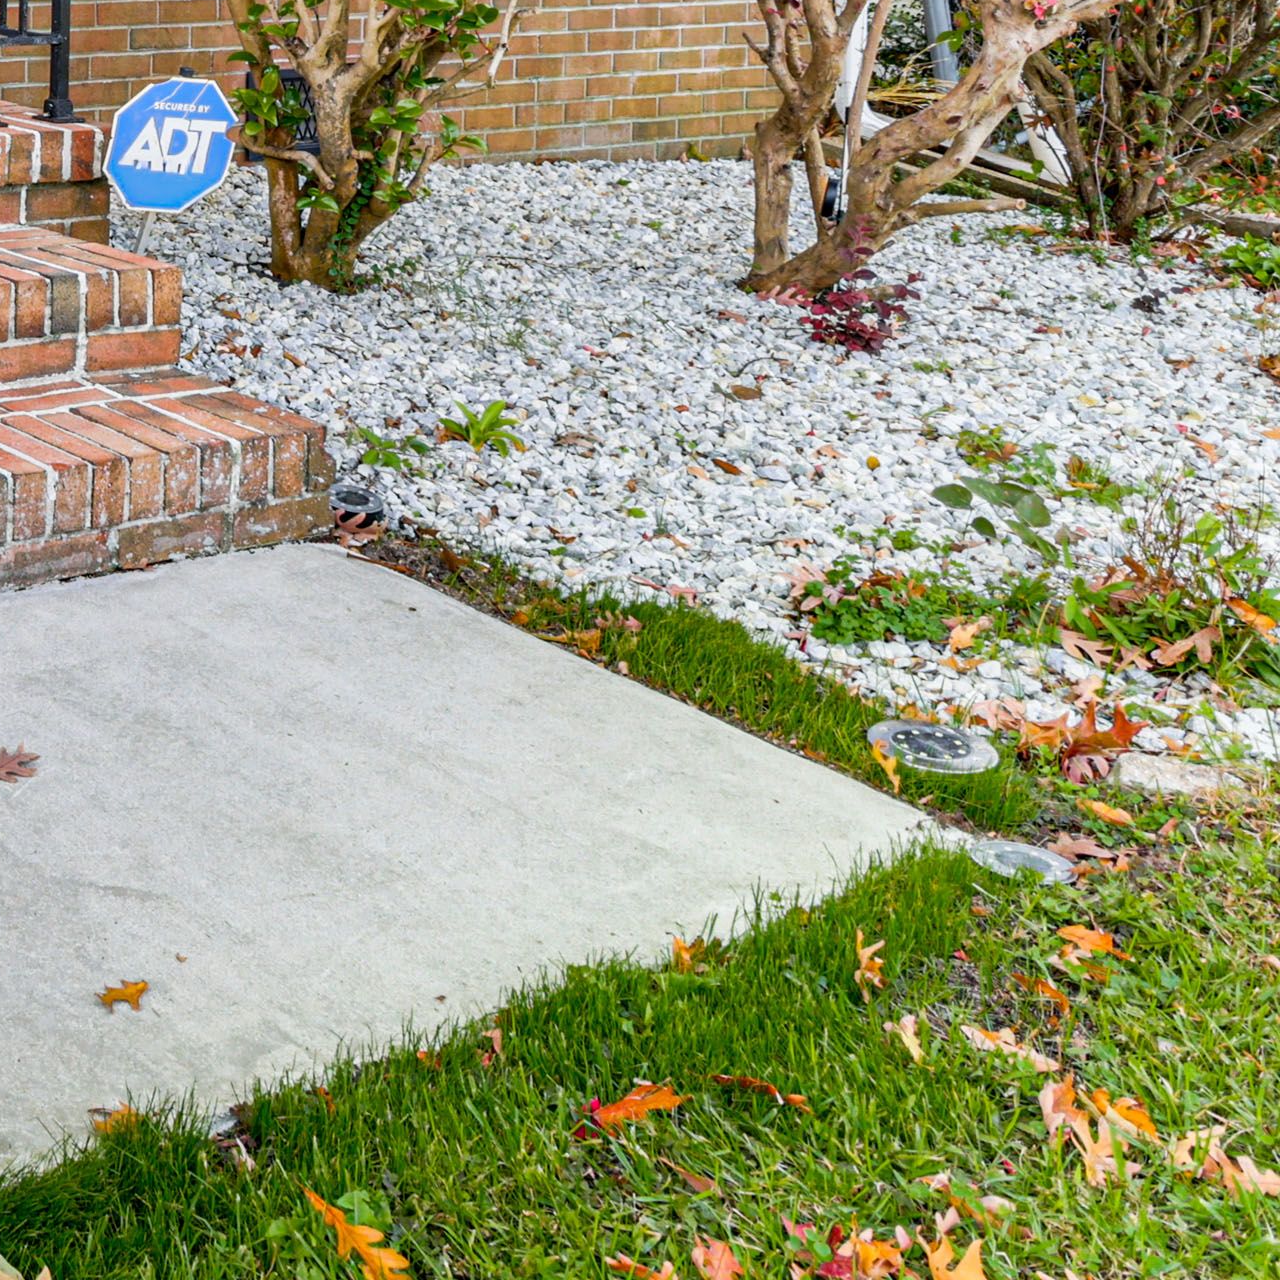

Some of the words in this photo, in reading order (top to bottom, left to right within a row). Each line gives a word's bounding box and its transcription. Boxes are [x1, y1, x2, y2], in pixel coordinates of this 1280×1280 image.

[153, 101, 195, 113] SECURED
[197, 104, 210, 113] BY
[118, 116, 228, 175] ADT
